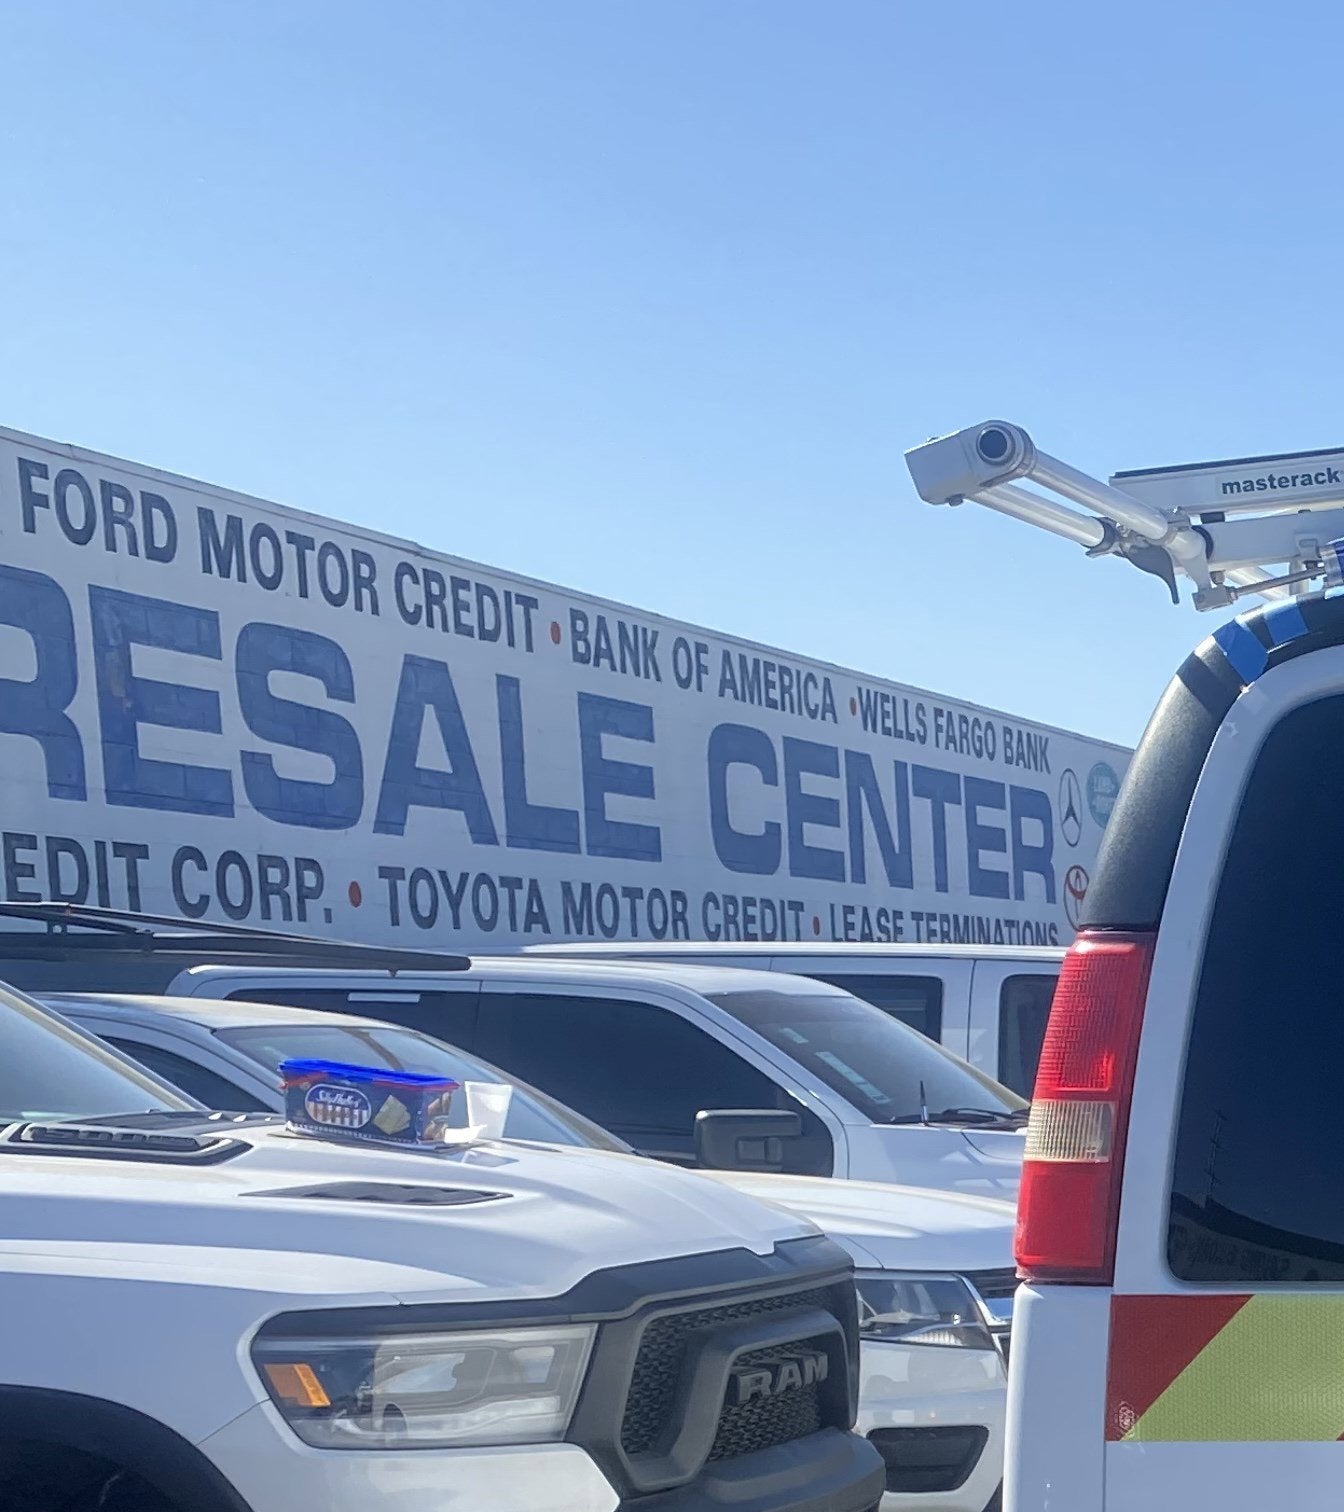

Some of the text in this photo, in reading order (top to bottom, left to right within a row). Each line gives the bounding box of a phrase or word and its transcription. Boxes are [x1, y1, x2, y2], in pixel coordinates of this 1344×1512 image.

[1222, 467, 1341, 494] masterack
[18, 456, 1051, 775] FORD MOTOR CREDIT BANK OF AMERICA WELLS FARGO BANK
[0, 564, 1057, 905] RESALE CENTER
[171, 845, 333, 924] CORP.
[378, 865, 551, 934] TOYOTA
[561, 882, 689, 941] MOTOR
[702, 891, 805, 943] CREDIT
[829, 903, 904, 943] LEASE
[911, 911, 1059, 946] TERMINATIONS
[739, 1351, 828, 1402] RAM
